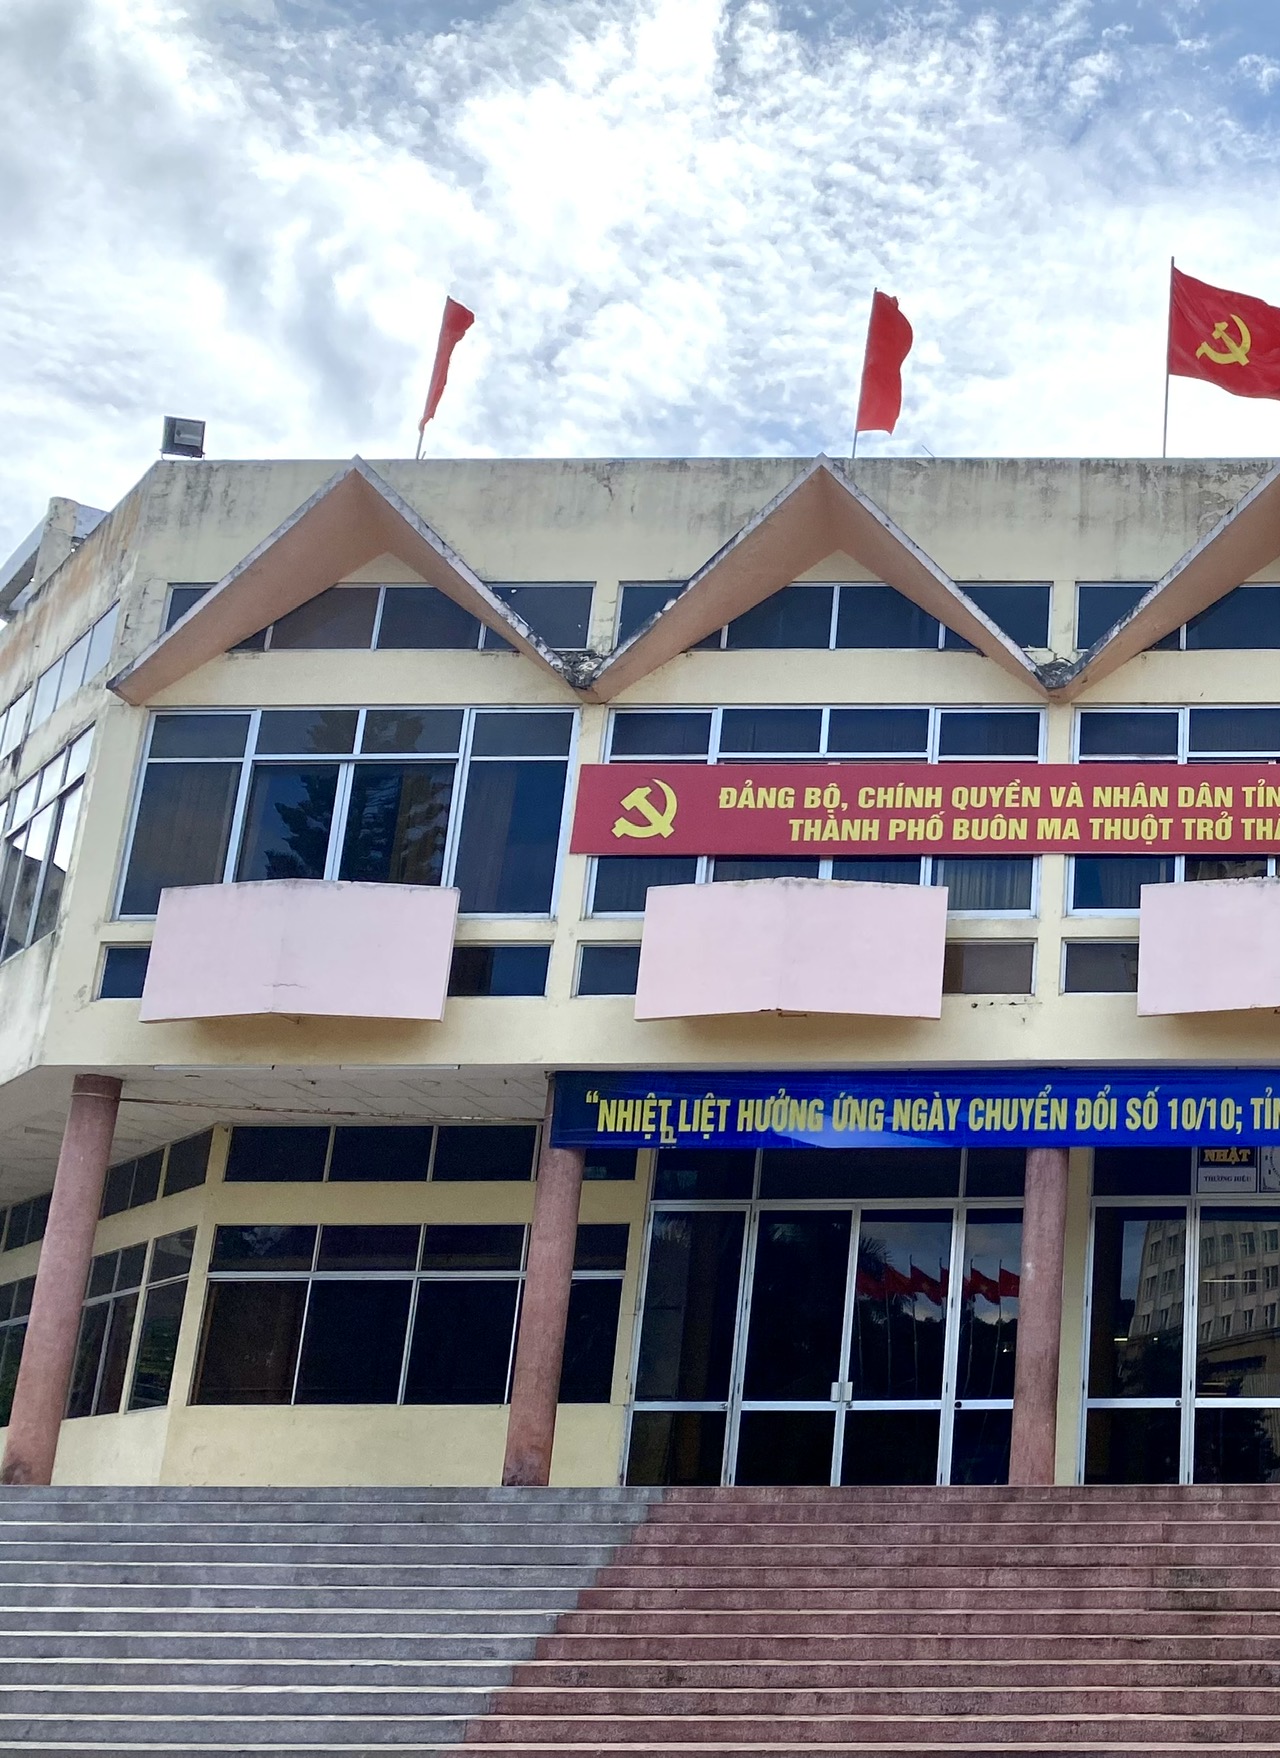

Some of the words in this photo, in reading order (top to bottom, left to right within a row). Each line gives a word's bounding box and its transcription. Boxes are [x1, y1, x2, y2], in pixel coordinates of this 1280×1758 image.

[718, 778, 796, 809] ĐẢNG
[803, 781, 849, 812] BỘ,
[857, 781, 943, 809] CHÍNH
[951, 777, 1041, 811] QUYỀN
[1049, 781, 1085, 808] VÀ
[1092, 780, 1169, 808] NHÂN
[1177, 780, 1233, 808] DÂN
[788, 813, 880, 842] THÀNH
[888, 808, 945, 841] PHỐ
[952, 812, 1028, 841] BUÔN
[1036, 818, 1081, 841] MA
[1088, 812, 1174, 845] THUỘT
[1181, 810, 1234, 841] TRỞ
[678, 1092, 731, 1140] LIỆT
[737, 1087, 824, 1132] HƯỞNG
[832, 1092, 885, 1132] ỨNG
[893, 1091, 961, 1131] NGÀY
[968, 1084, 1068, 1131] CHUYỂN
[1076, 1084, 1117, 1131] ĐỔI
[1126, 1086, 1160, 1131] SỐ
[1168, 1098, 1242, 1134] 10/10;
[1203, 1146, 1251, 1165] NHẬT
